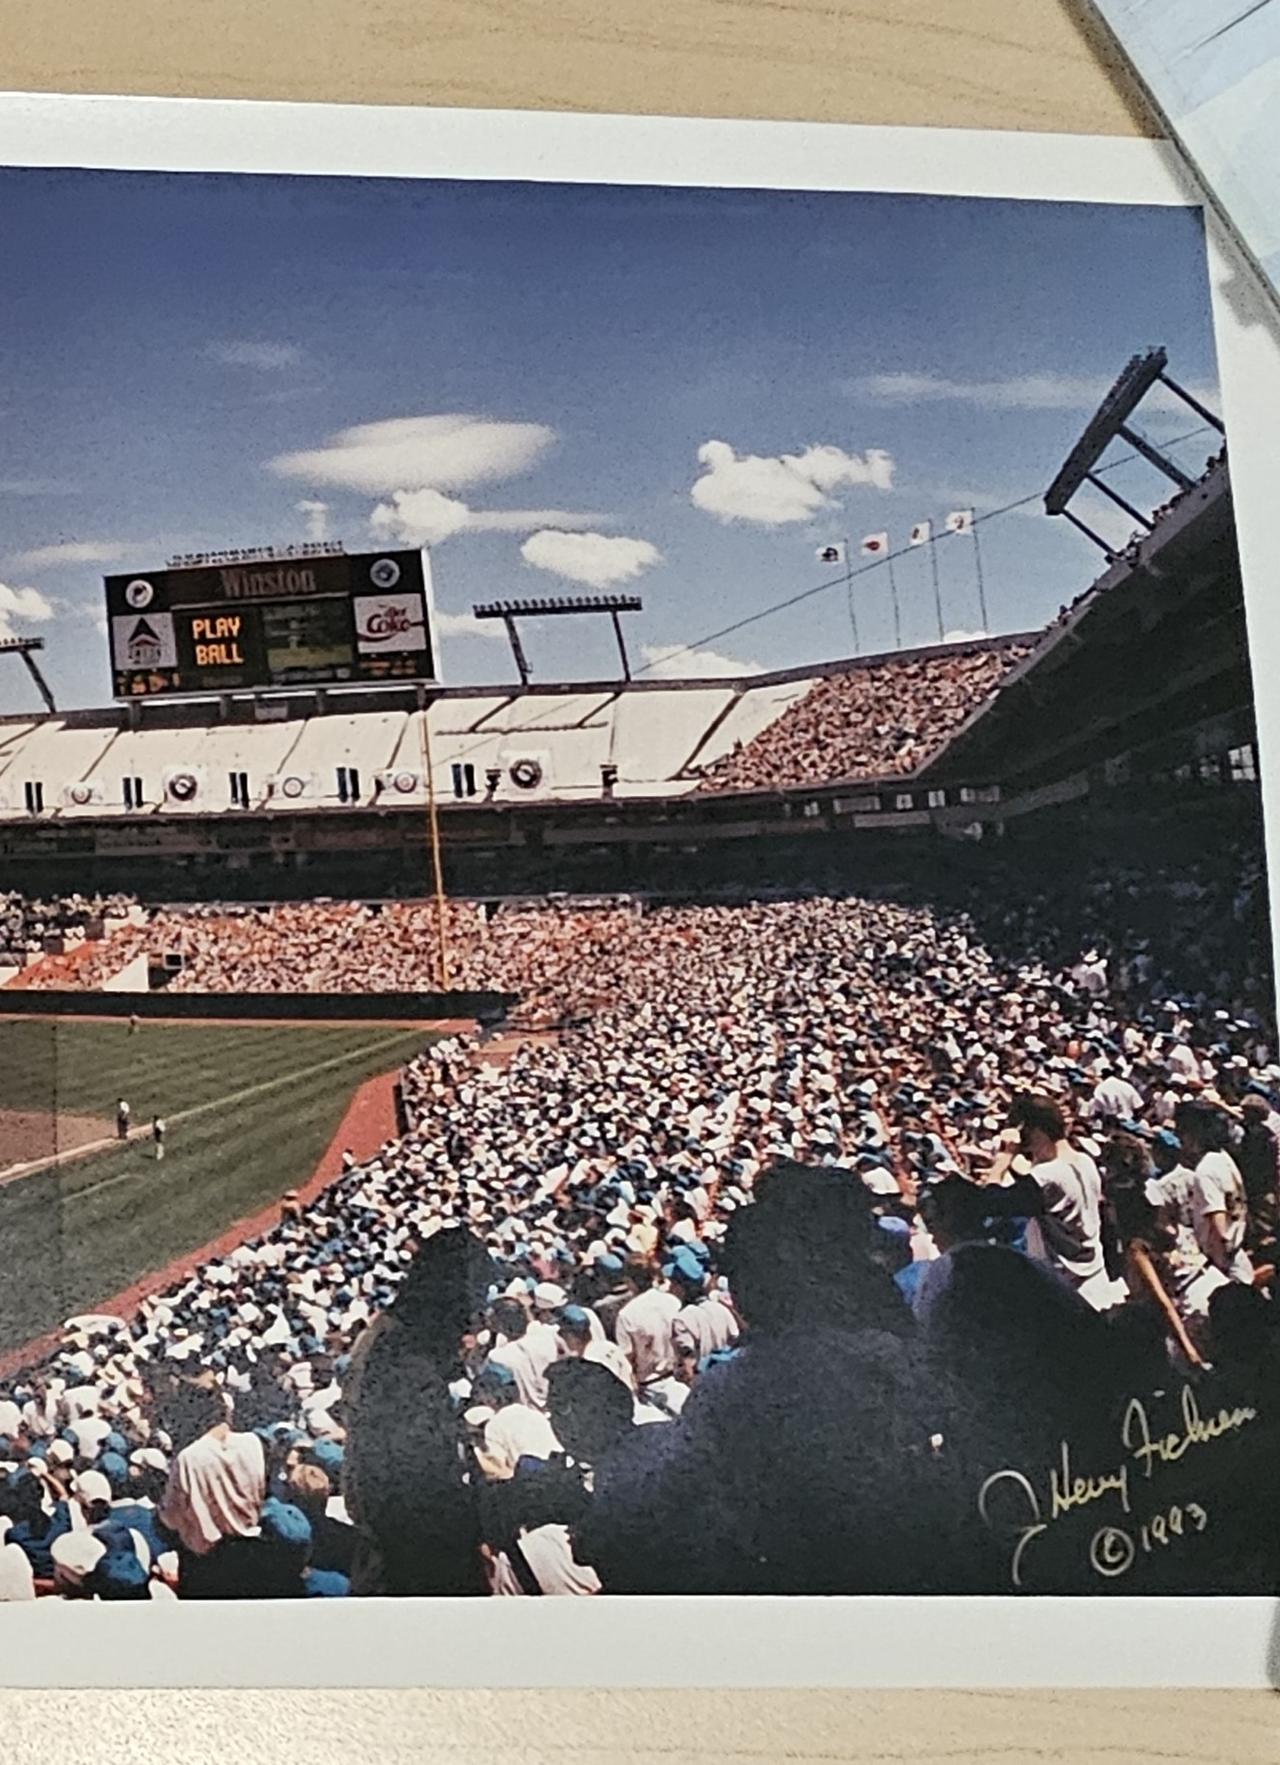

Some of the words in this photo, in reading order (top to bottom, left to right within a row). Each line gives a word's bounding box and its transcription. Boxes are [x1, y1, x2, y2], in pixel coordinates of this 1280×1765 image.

[221, 570, 316, 597] Winston
[193, 617, 241, 640] PLAY
[196, 643, 244, 666] BALL
